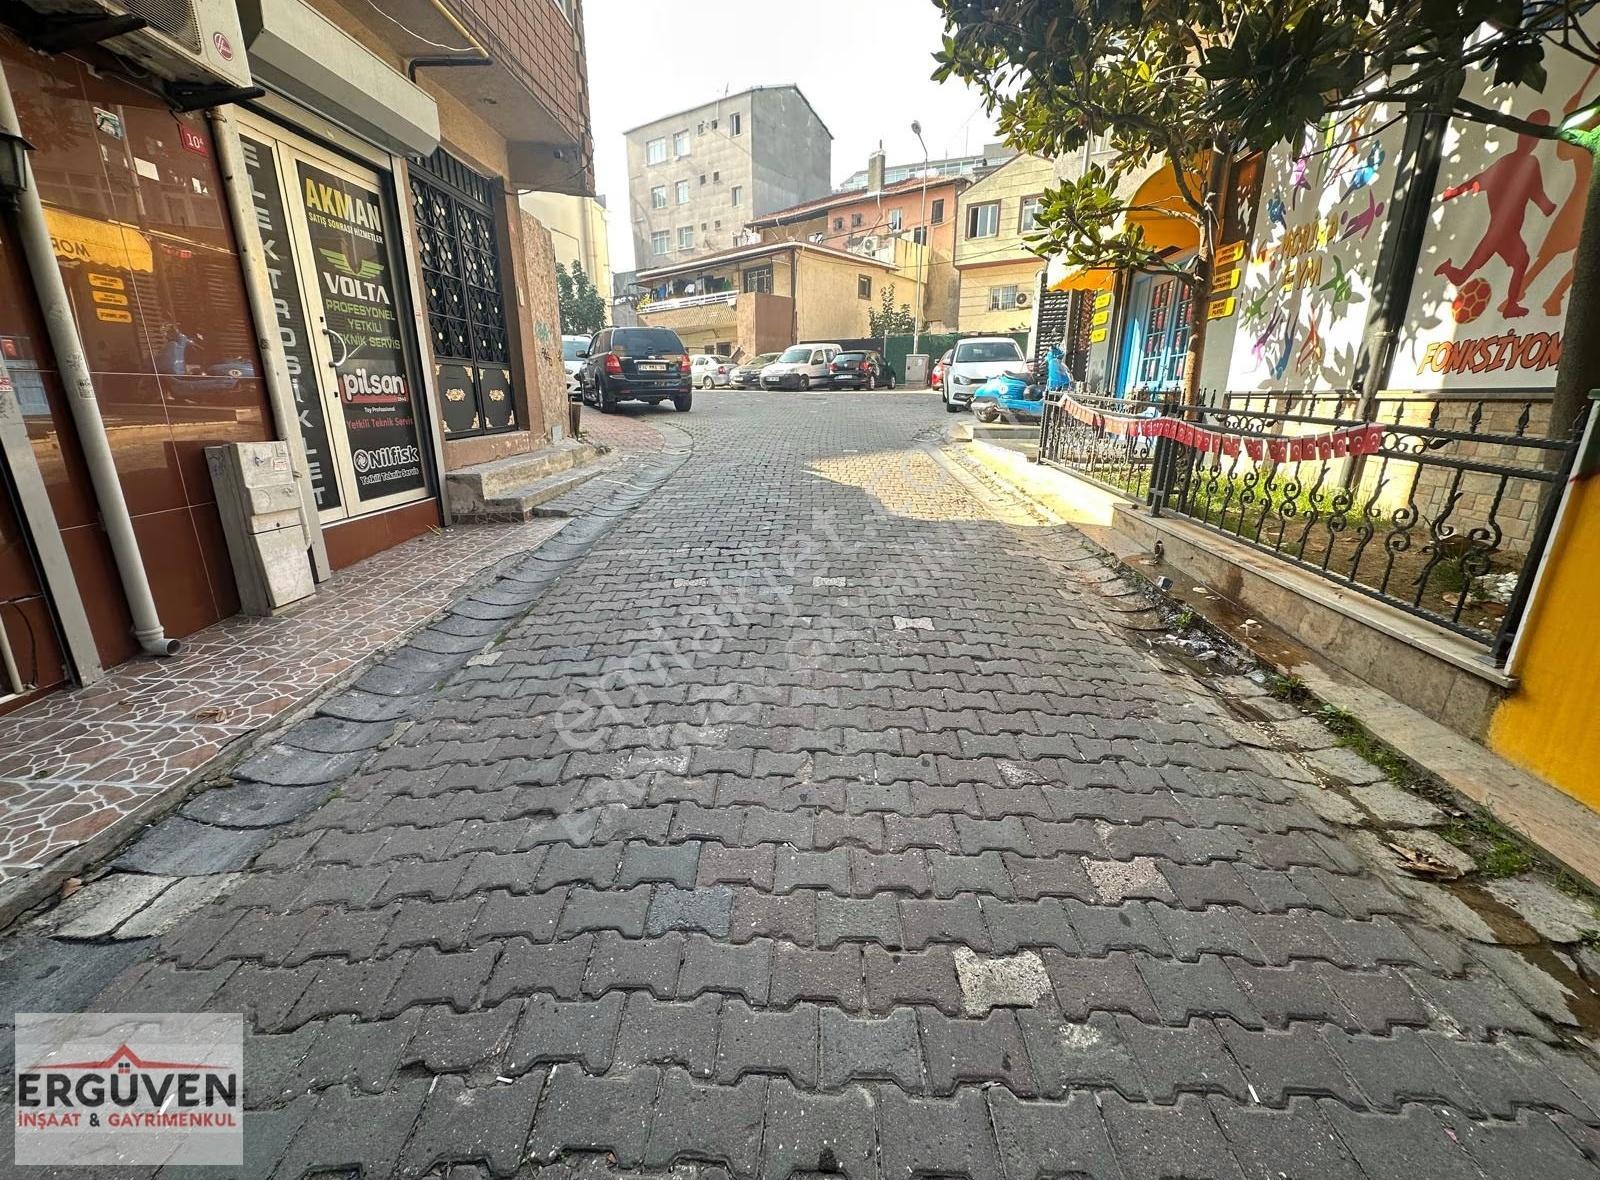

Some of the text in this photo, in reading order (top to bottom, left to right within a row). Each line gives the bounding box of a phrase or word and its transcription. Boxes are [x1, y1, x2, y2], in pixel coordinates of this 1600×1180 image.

[305, 177, 383, 233] AKMAN
[308, 211, 327, 228] SATIŞ
[327, 218, 354, 235] SONRASI
[322, 271, 391, 305] VOLTA
[325, 298, 396, 321] PROFESYONEL
[332, 332, 368, 346] TKNİK
[342, 368, 405, 401] pilsan
[371, 418, 394, 428] Teknik
[367, 445, 420, 470] Nilfisk
[360, 473, 382, 486] Yetkili
[381, 469, 402, 481] Teknik
